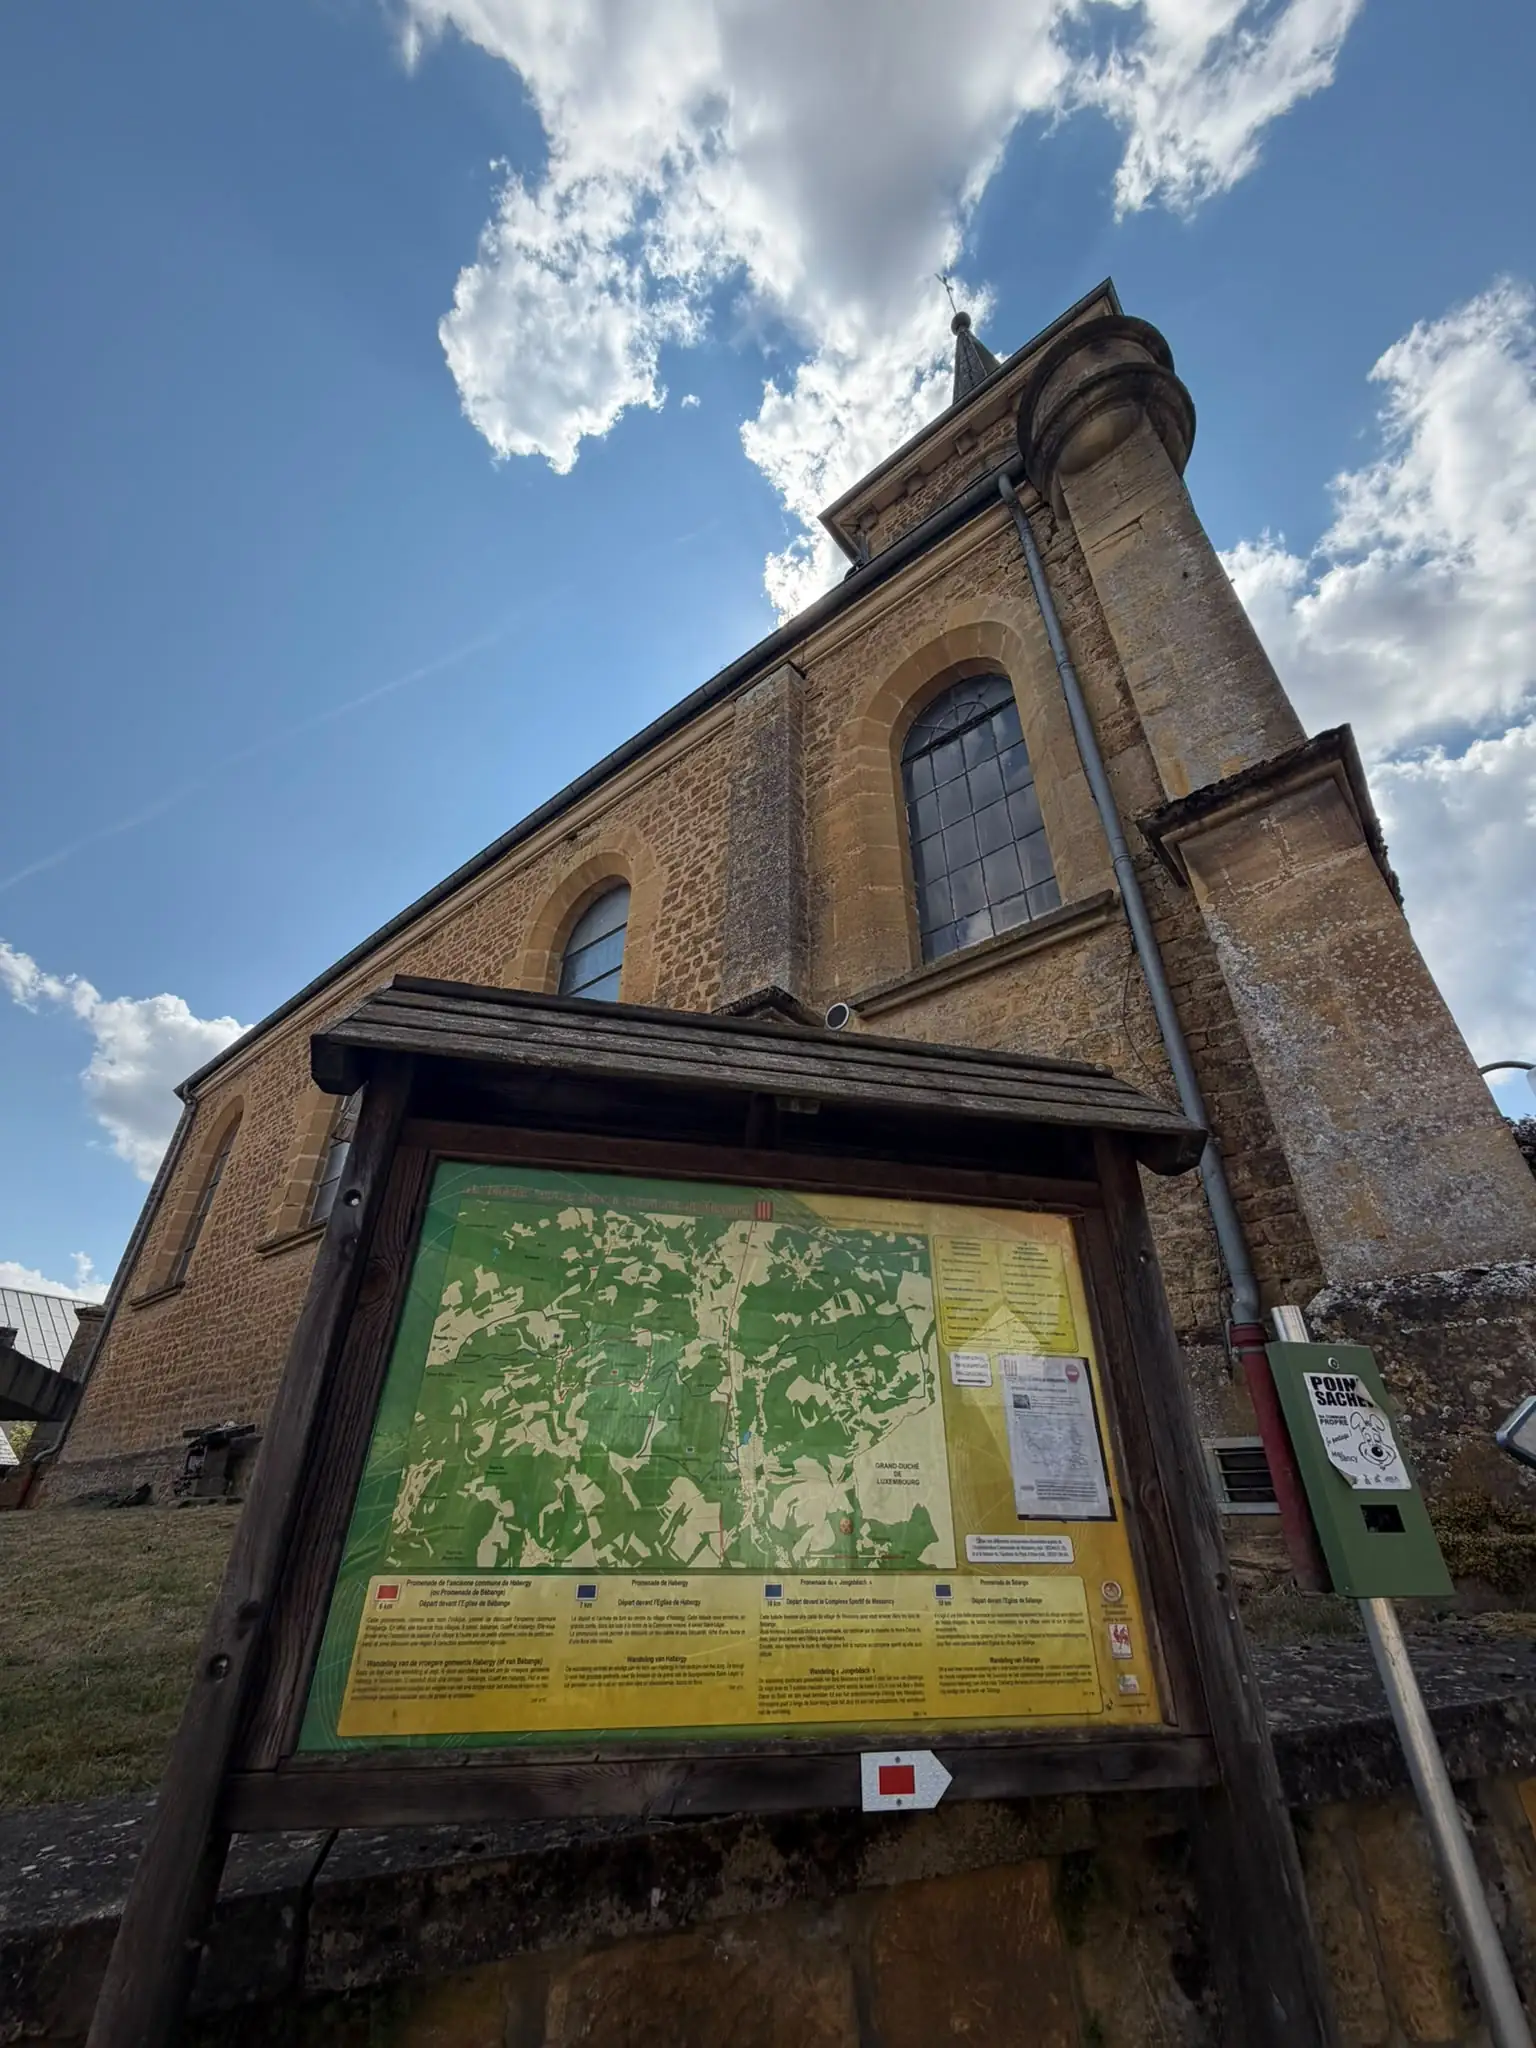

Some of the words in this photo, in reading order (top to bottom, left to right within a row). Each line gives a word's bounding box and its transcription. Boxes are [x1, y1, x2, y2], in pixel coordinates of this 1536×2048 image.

[1310, 1376, 1359, 1392] POIN
[893, 1470, 902, 1478] DE
[876, 1478, 920, 1486] LUXEMBOURG
[407, 1579, 437, 1587] Promenade
[441, 1588, 471, 1596] Promenade
